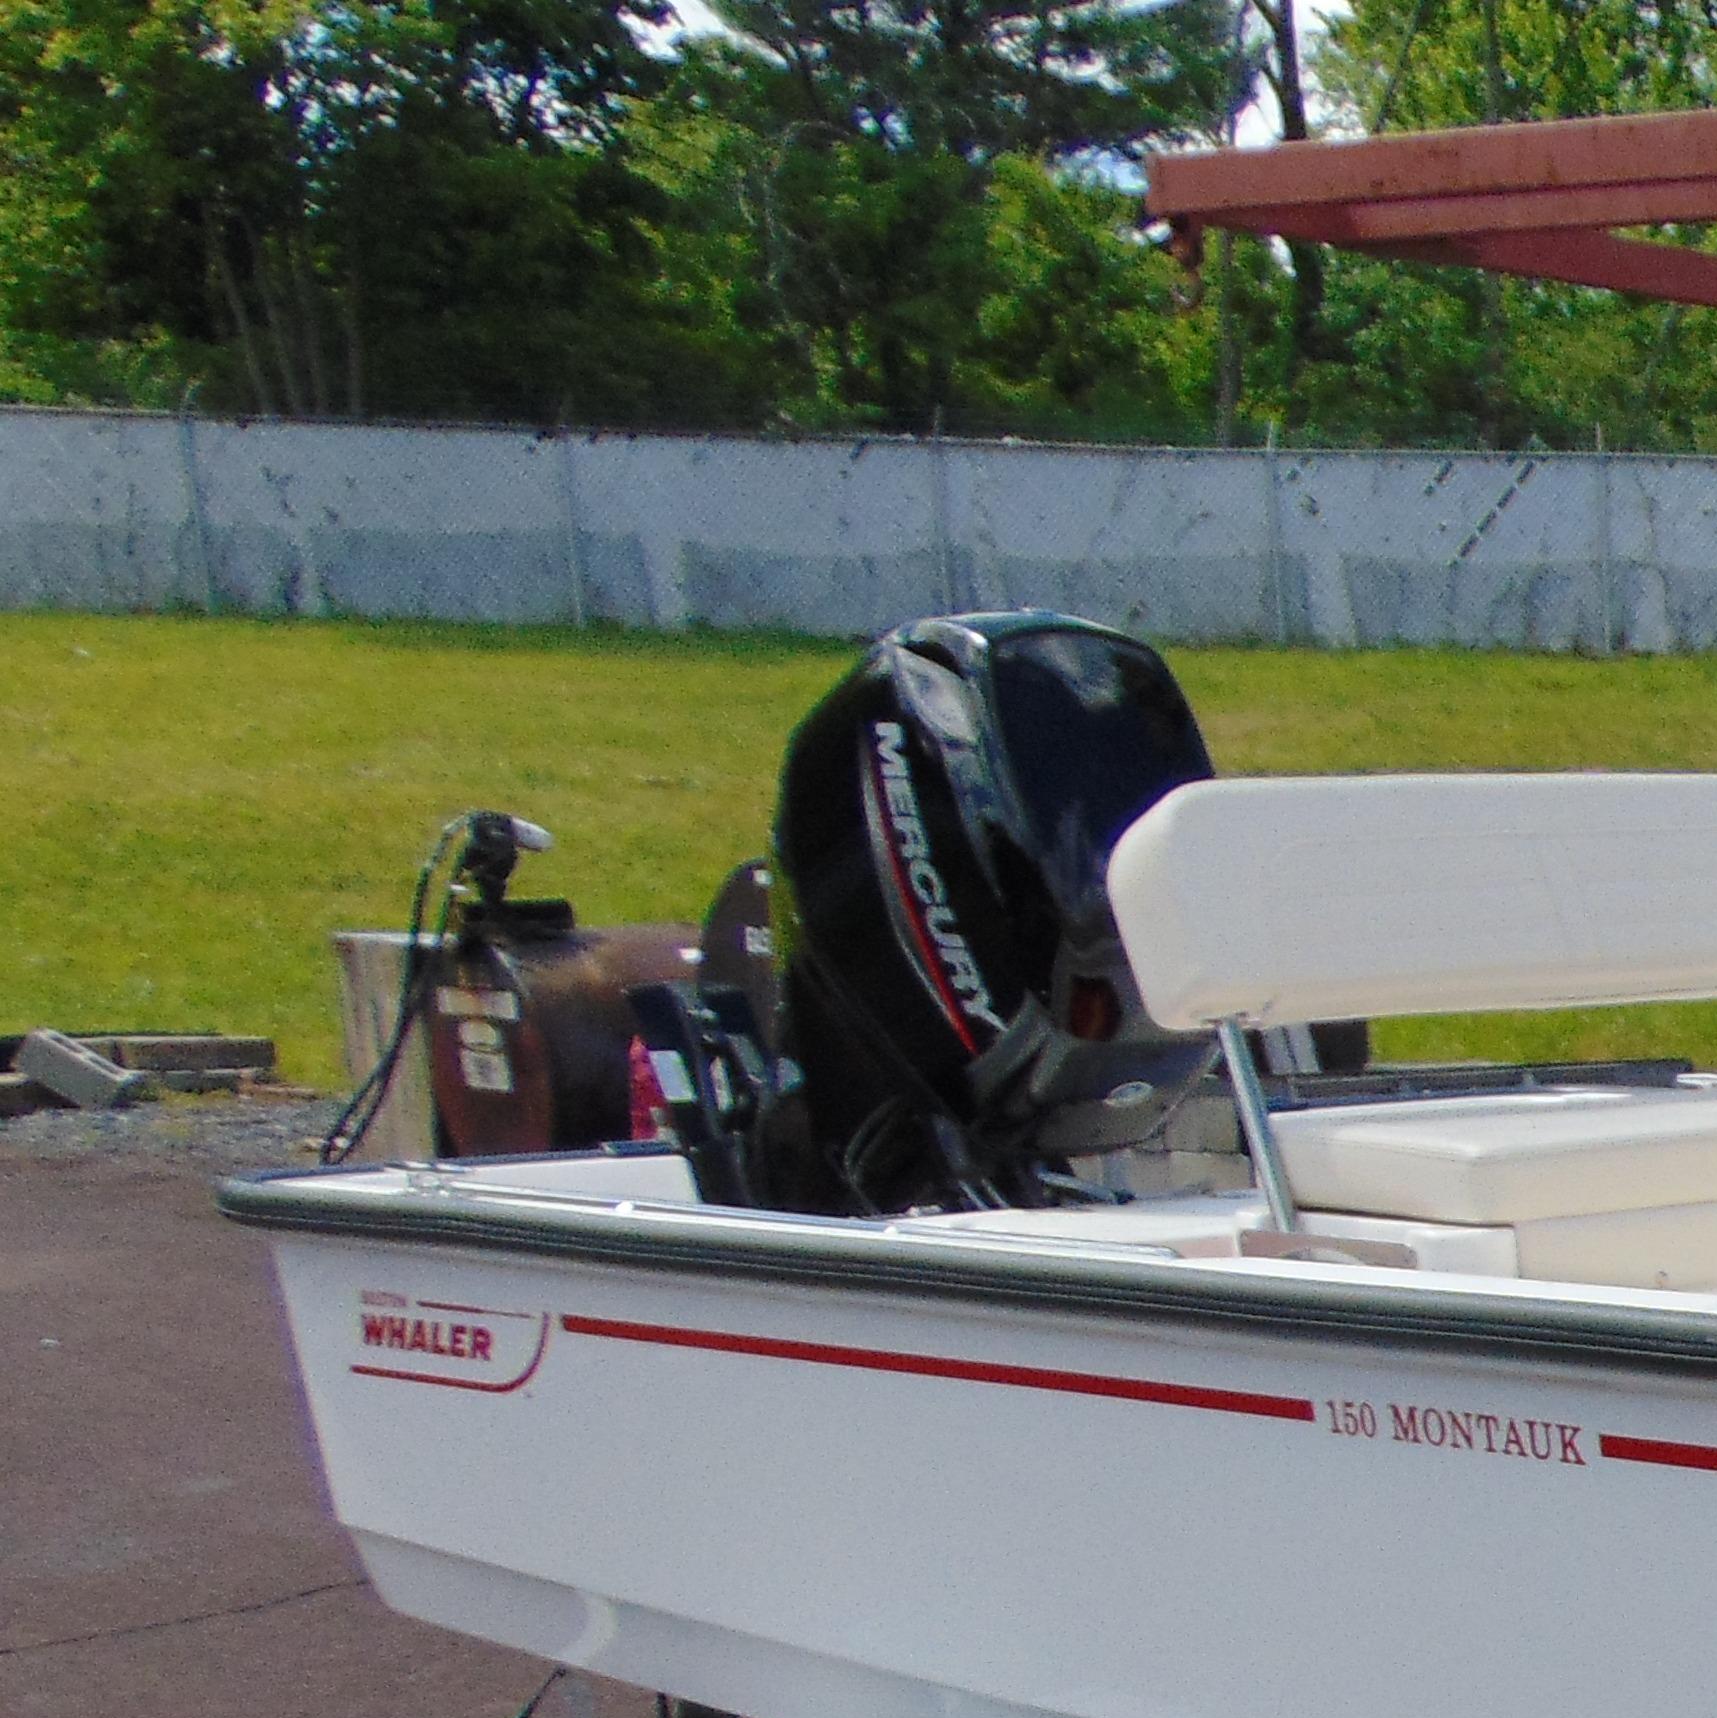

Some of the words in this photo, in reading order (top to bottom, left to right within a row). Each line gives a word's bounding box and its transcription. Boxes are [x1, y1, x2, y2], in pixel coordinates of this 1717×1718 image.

[874, 721, 1009, 1032] MERCURY
[361, 1313, 493, 1362] WHALER
[1327, 1400, 1377, 1438] 150
[1388, 1403, 1587, 1466] MONTAUK
